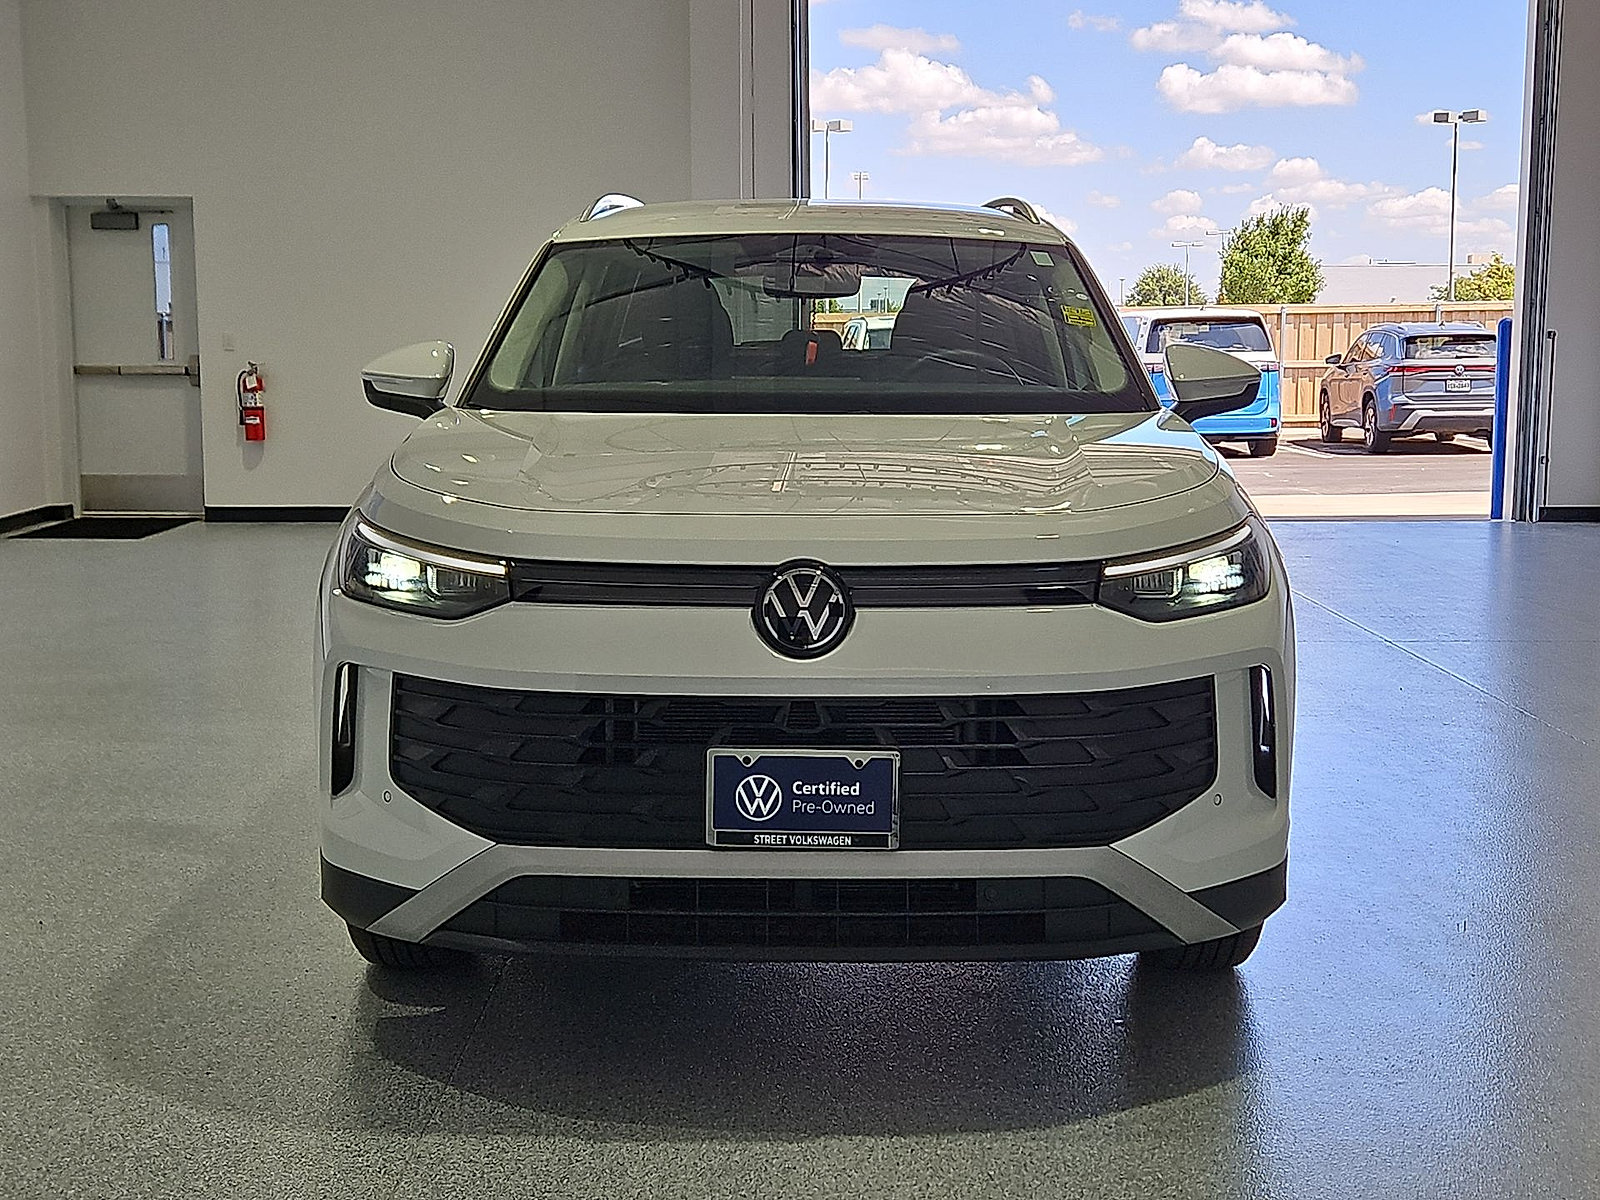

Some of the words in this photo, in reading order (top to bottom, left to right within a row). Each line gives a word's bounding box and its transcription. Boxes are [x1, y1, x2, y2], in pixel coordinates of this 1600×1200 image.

[792, 781, 860, 796] Certified
[736, 775, 782, 821] VW
[792, 799, 875, 815] Pre-Owned
[753, 834, 787, 845] STREET
[789, 835, 852, 846] VOLKSWAGEN
